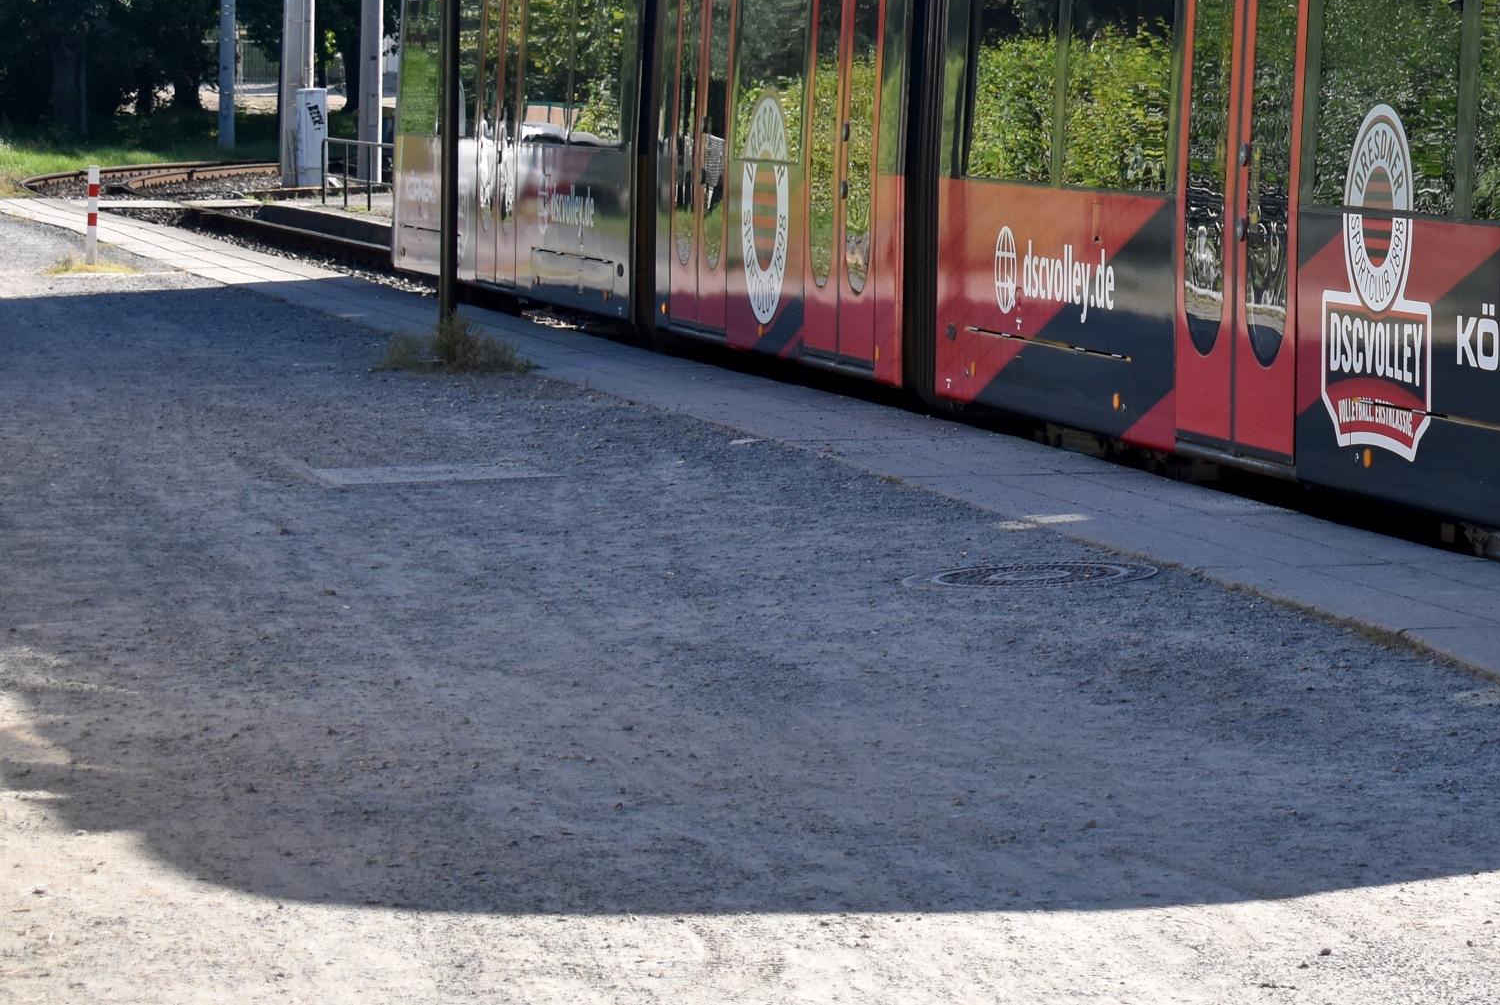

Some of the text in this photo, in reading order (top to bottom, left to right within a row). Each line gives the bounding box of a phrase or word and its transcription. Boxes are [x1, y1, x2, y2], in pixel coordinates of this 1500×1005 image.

[1355, 129, 1403, 197] DRESDNER
[1023, 239, 1115, 324] dscvolley.de
[1350, 215, 1406, 304] SPORTCLUB 1898
[1330, 311, 1424, 387] DSCVOLLEY
